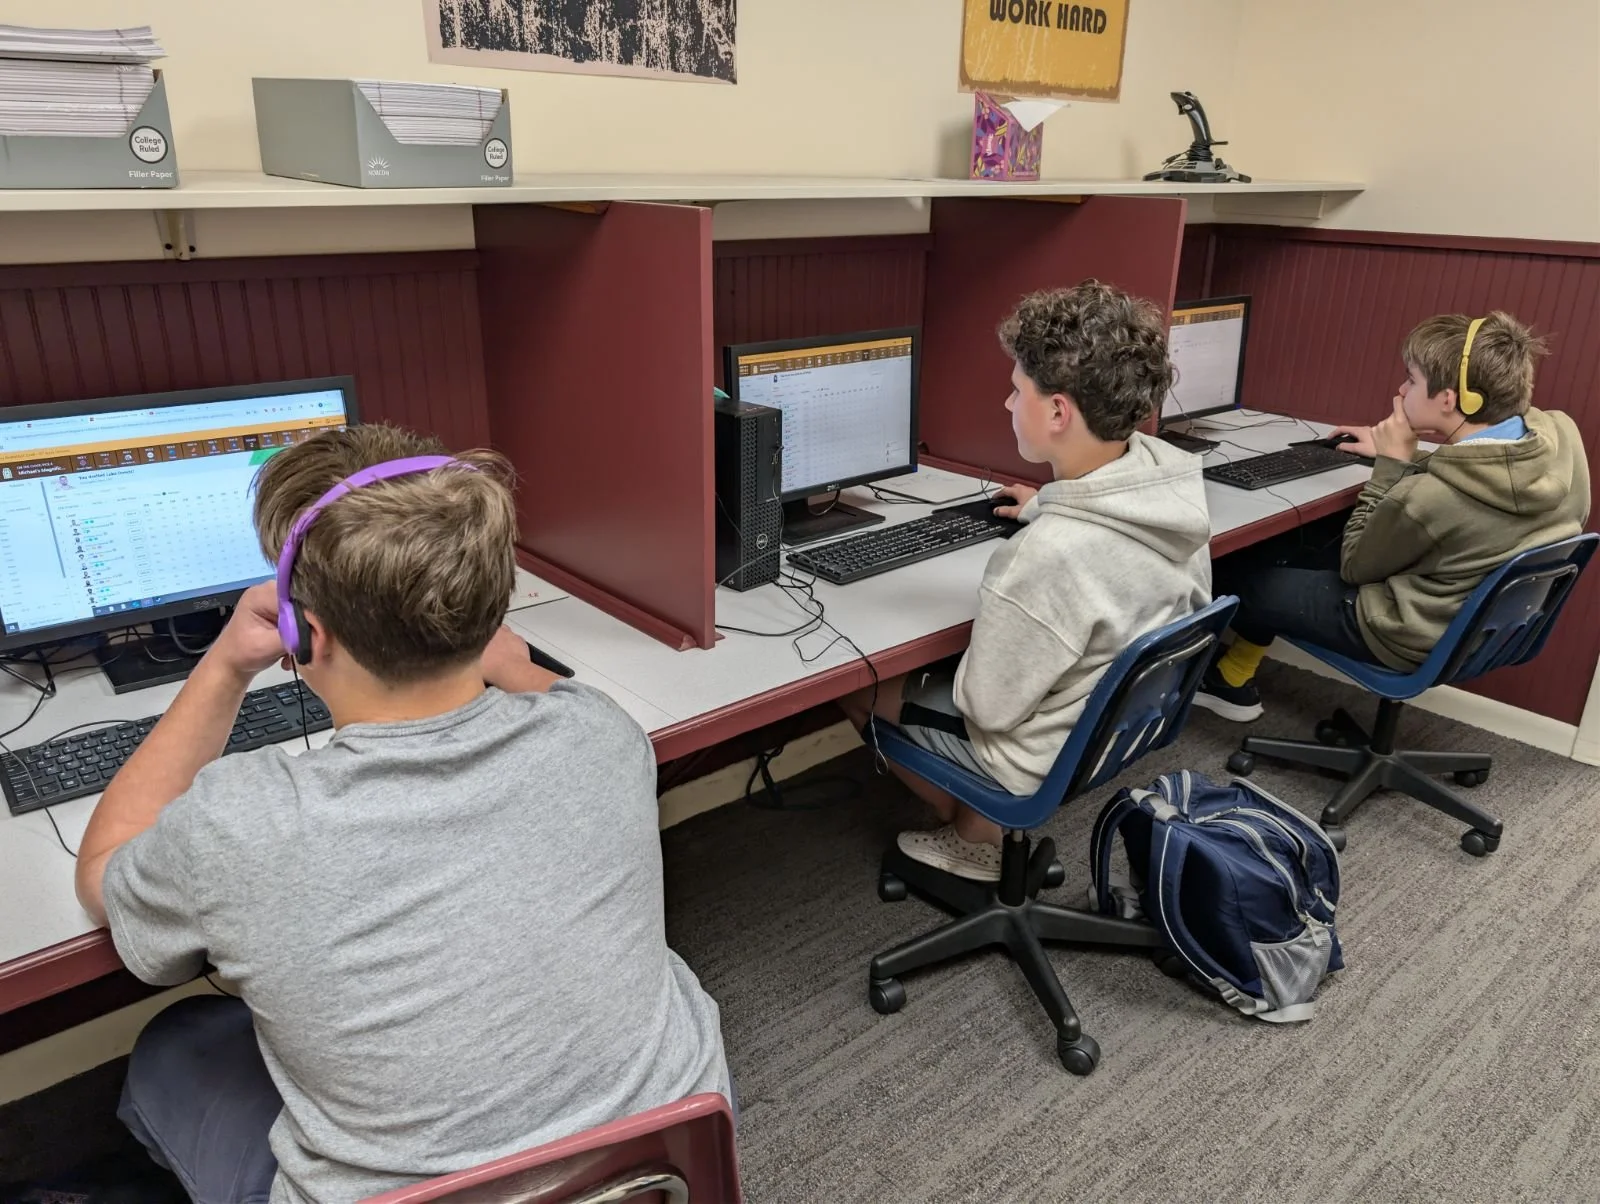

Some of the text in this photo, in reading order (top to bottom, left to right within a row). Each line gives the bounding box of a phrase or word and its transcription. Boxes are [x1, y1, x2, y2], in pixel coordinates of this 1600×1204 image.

[990, 0, 1107, 35] WORK HARD
[134, 136, 162, 145] College
[139, 145, 160, 153] Ruled
[487, 145, 505, 154] College
[128, 170, 173, 179] Filler Paper
[494, 174, 510, 183] Paper
